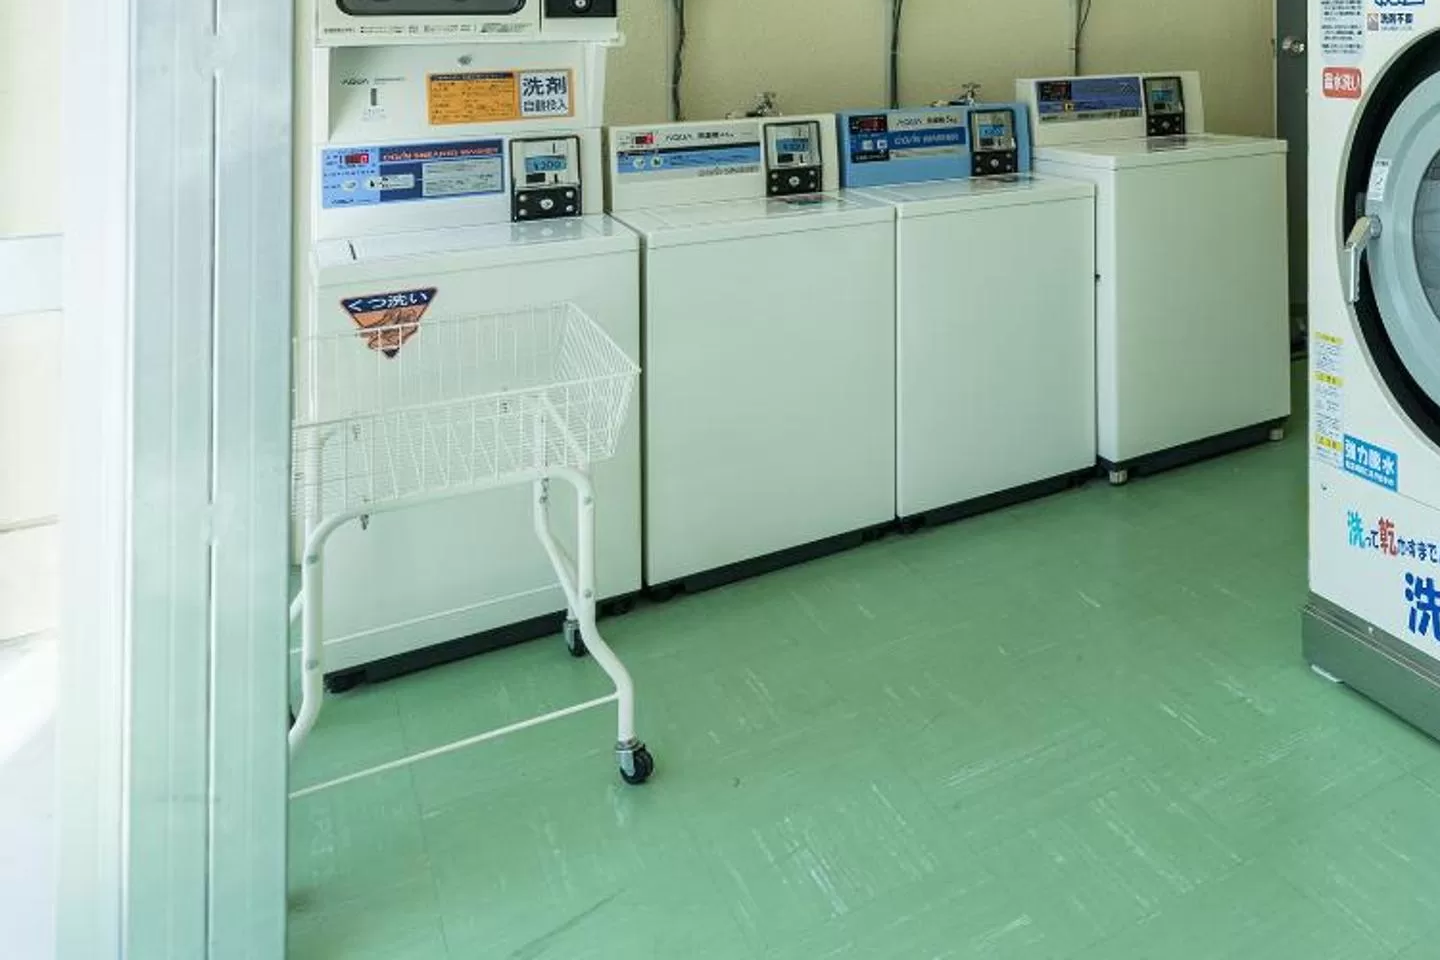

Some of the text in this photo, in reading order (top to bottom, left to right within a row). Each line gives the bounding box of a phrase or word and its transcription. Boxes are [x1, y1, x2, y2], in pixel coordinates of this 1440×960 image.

[522, 76, 568, 97] 洗剤
[348, 293, 429, 312] くつ洗い
